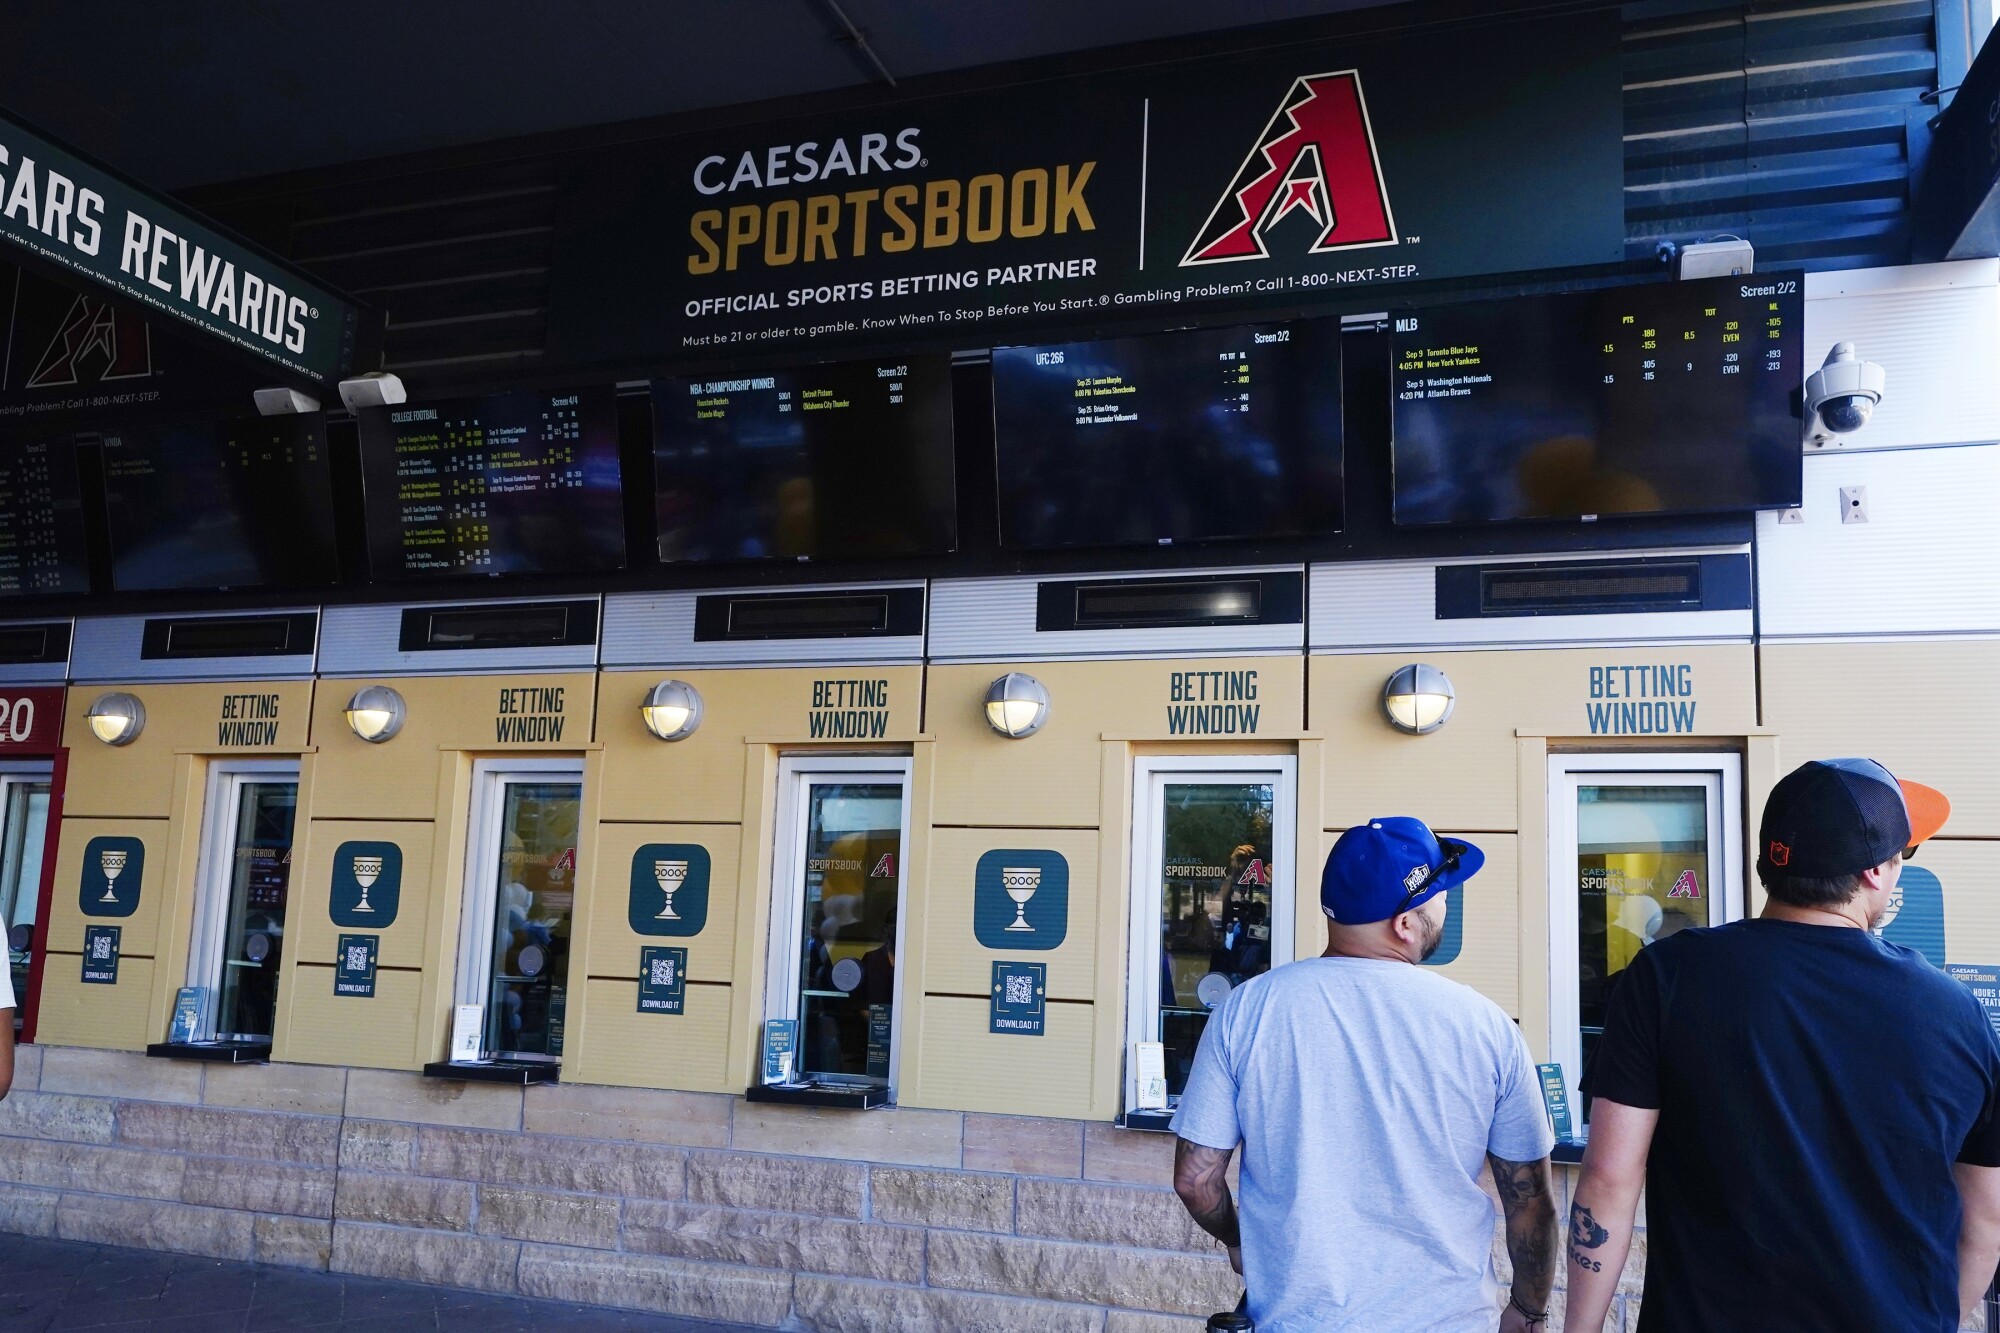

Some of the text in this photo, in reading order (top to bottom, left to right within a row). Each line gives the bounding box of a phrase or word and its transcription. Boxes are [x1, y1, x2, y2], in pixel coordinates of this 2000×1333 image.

[687, 161, 1097, 275] SPORTSBOOK
[685, 258, 1097, 317] OFFICIAL SPORTS BETTING PARTNER
[1741, 281, 1796, 297] Screen 2/2
[7, 232, 28, 246] older
[29, 242, 39, 250] to
[40, 247, 72, 266] gamble.
[73, 261, 95, 276] Know
[95, 271, 117, 287] When
[117, 281, 126, 291] To
[126, 286, 143, 299] Stop
[144, 294, 166, 310] Before
[167, 304, 180, 316] You
[205, 322, 236, 343] Gambling
[236, 337, 264, 354] Problem?
[264, 350, 276, 361] Call
[682, 335, 711, 347] Must
[713, 334, 728, 345] be
[731, 332, 742, 343] 21
[745, 332, 758, 341] or
[761, 327, 790, 340] older
[794, 326, 806, 336] to
[809, 319, 859, 337] gamble.
[862, 315, 896, 329] Know
[899, 312, 935, 326] When
[938, 310, 952, 321] To
[955, 307, 984, 323] Stop
[987, 303, 1030, 318] Before
[1033, 300, 1057, 312] You
[1114, 289, 1181, 305] Gambling
[1186, 280, 1252, 298] Problem?
[1256, 277, 1284, 291] Call
[1287, 264, 1420, 288] 1-800-NEXT-STEP.
[1623, 316, 1634, 324] PTS
[1705, 308, 1716, 316] TOT
[1396, 318, 1418, 332] MLB
[1255, 330, 1289, 343] Screen 2/2
[1406, 351, 1417, 359] Sep
[1418, 350, 1423, 358] 9
[1427, 348, 1449, 356] Toronto
[1465, 346, 1478, 354] Jays
[1684, 332, 1695, 340] 8.5
[1766, 318, 1781, 326] -105
[1036, 352, 1064, 365] UFC 266
[1399, 334, 1739, 370] 4:05 PM New York Yankees -155 EVEN
[877, 366, 907, 377] Screen 2/2
[1406, 381, 1418, 389] Sep
[1427, 377, 1462, 386] Washington
[1464, 374, 1492, 384] Nationals
[1642, 360, 1655, 368] -105
[1766, 350, 1781, 358] -193
[690, 378, 775, 395] NBA CHAMPIONSHIP WINNER
[1077, 379, 1085, 387] Sep
[1085, 378, 1091, 386] 25
[1107, 376, 1122, 384] Murphy
[1400, 392, 1413, 400] 4:20
[1428, 390, 1449, 398] Atlanta
[1450, 388, 1471, 396] Braves
[1723, 365, 1739, 374] EVEN
[779, 392, 790, 400] 500/1
[890, 383, 902, 391] 500/1
[26, 391, 161, 413] Problem? Call 1-800-NEXT-STEP.
[552, 398, 568, 406] Screen
[824, 401, 832, 409] City
[890, 395, 902, 403] 500/1
[1078, 406, 1086, 414] Sep
[1094, 405, 1104, 413] Brian
[1105, 404, 1118, 412] Ortega
[392, 409, 438, 422] COLLEGE FOOTBALL
[1094, 415, 1113, 423] Alexander
[1170, 671, 1258, 701] BETTING
[1590, 664, 1691, 698] BETTING
[500, 687, 565, 714] BETTING
[812, 680, 888, 709] BETTING
[222, 694, 279, 720] BETTING
[809, 711, 889, 738] WINDOW
[1167, 704, 1260, 734] WINDOW
[1586, 701, 1696, 734] WINDOW
[218, 722, 279, 746] WINDOW
[496, 716, 565, 743] WINDOW
[810, 860, 862, 870] SPORTSBOOK
[1166, 866, 1227, 877] SPORTSBOOK
[1952, 974, 1997, 982] SPORTSBOOK
[338, 984, 365, 992] DOWNLOAD
[1973, 989, 1995, 997] HOURS
[642, 1000, 679, 1009] DOWNLOAD IT
[996, 1019, 1040, 1029] DOWNLOAD IT
